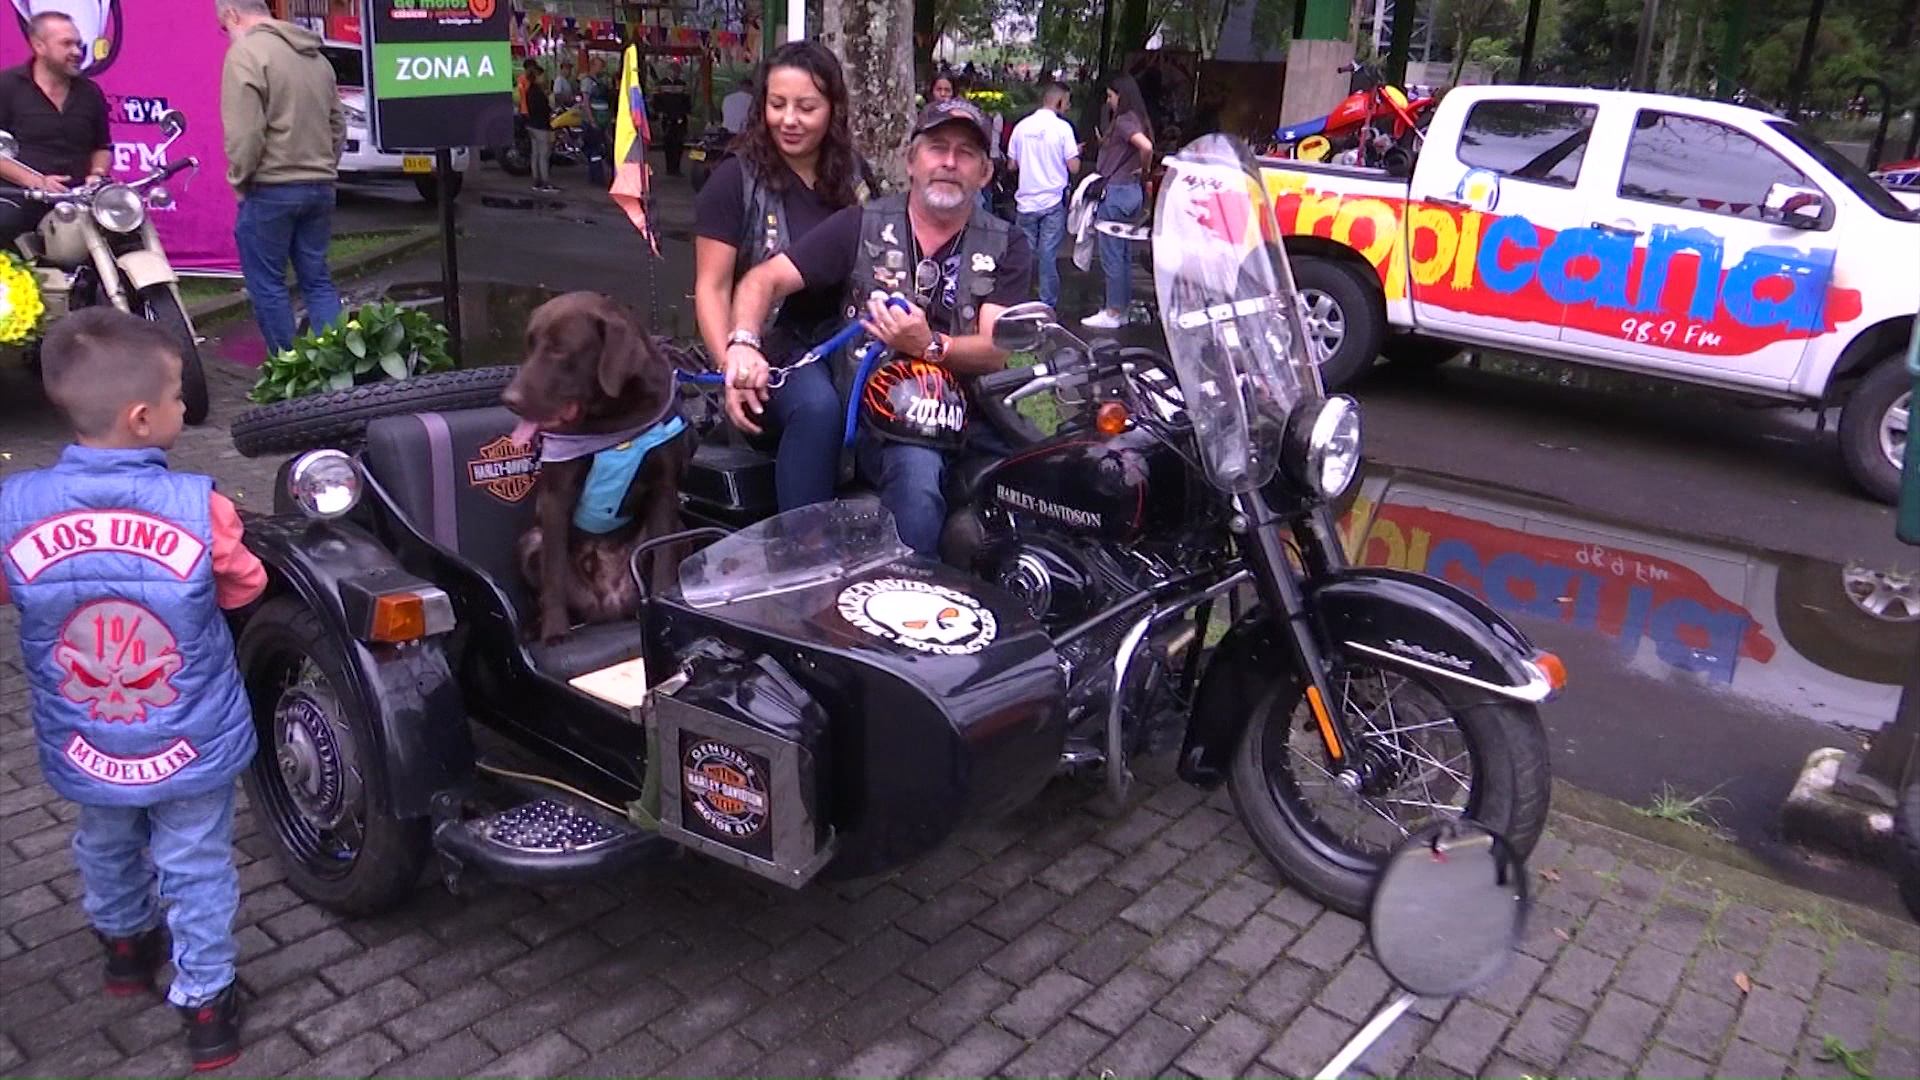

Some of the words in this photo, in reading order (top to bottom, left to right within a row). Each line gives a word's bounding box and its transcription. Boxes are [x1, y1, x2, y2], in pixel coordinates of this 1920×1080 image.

[395, 55, 470, 80] ZONA
[477, 55, 494, 76] A
[1243, 167, 1838, 333] Tropicana
[1621, 318, 1677, 344] 98.9
[996, 483, 1102, 528] HARLEY-DAVIDSON
[31, 519, 98, 560] LOS
[110, 518, 180, 557] UNO
[94, 613, 146, 666] 1%
[72, 742, 192, 780] MEDELLIN
[691, 743, 755, 777] GENUINE
[693, 801, 732, 832] MOTOR
